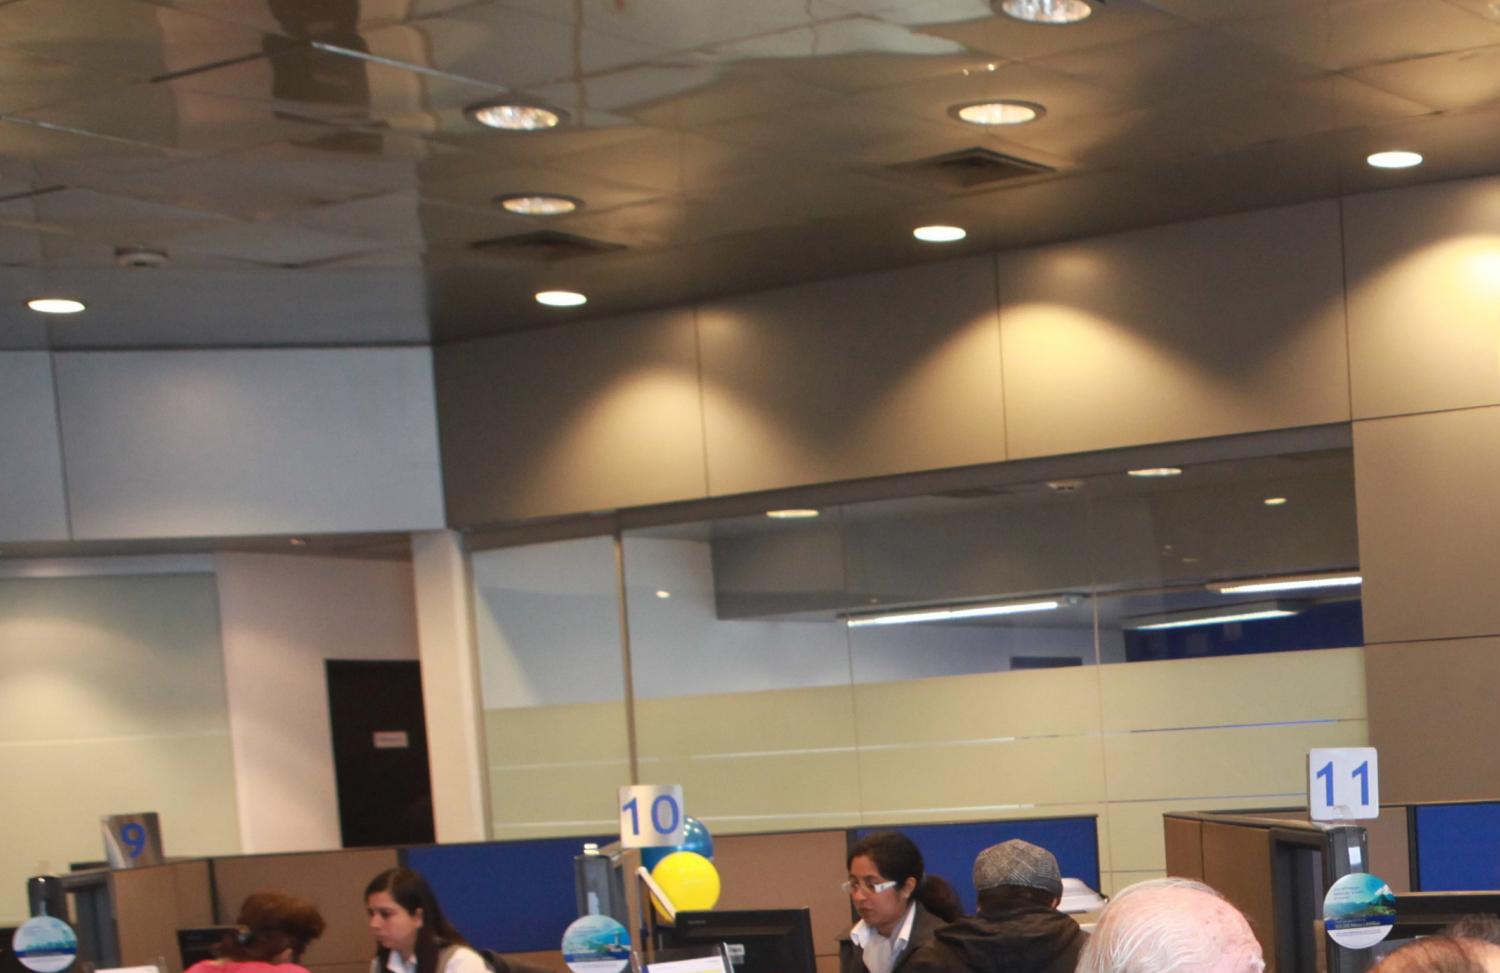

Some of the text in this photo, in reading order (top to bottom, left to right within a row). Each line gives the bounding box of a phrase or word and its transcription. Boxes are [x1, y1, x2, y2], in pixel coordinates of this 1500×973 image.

[1316, 760, 1369, 807] 11
[622, 794, 680, 836] 10
[121, 822, 146, 858] 9
